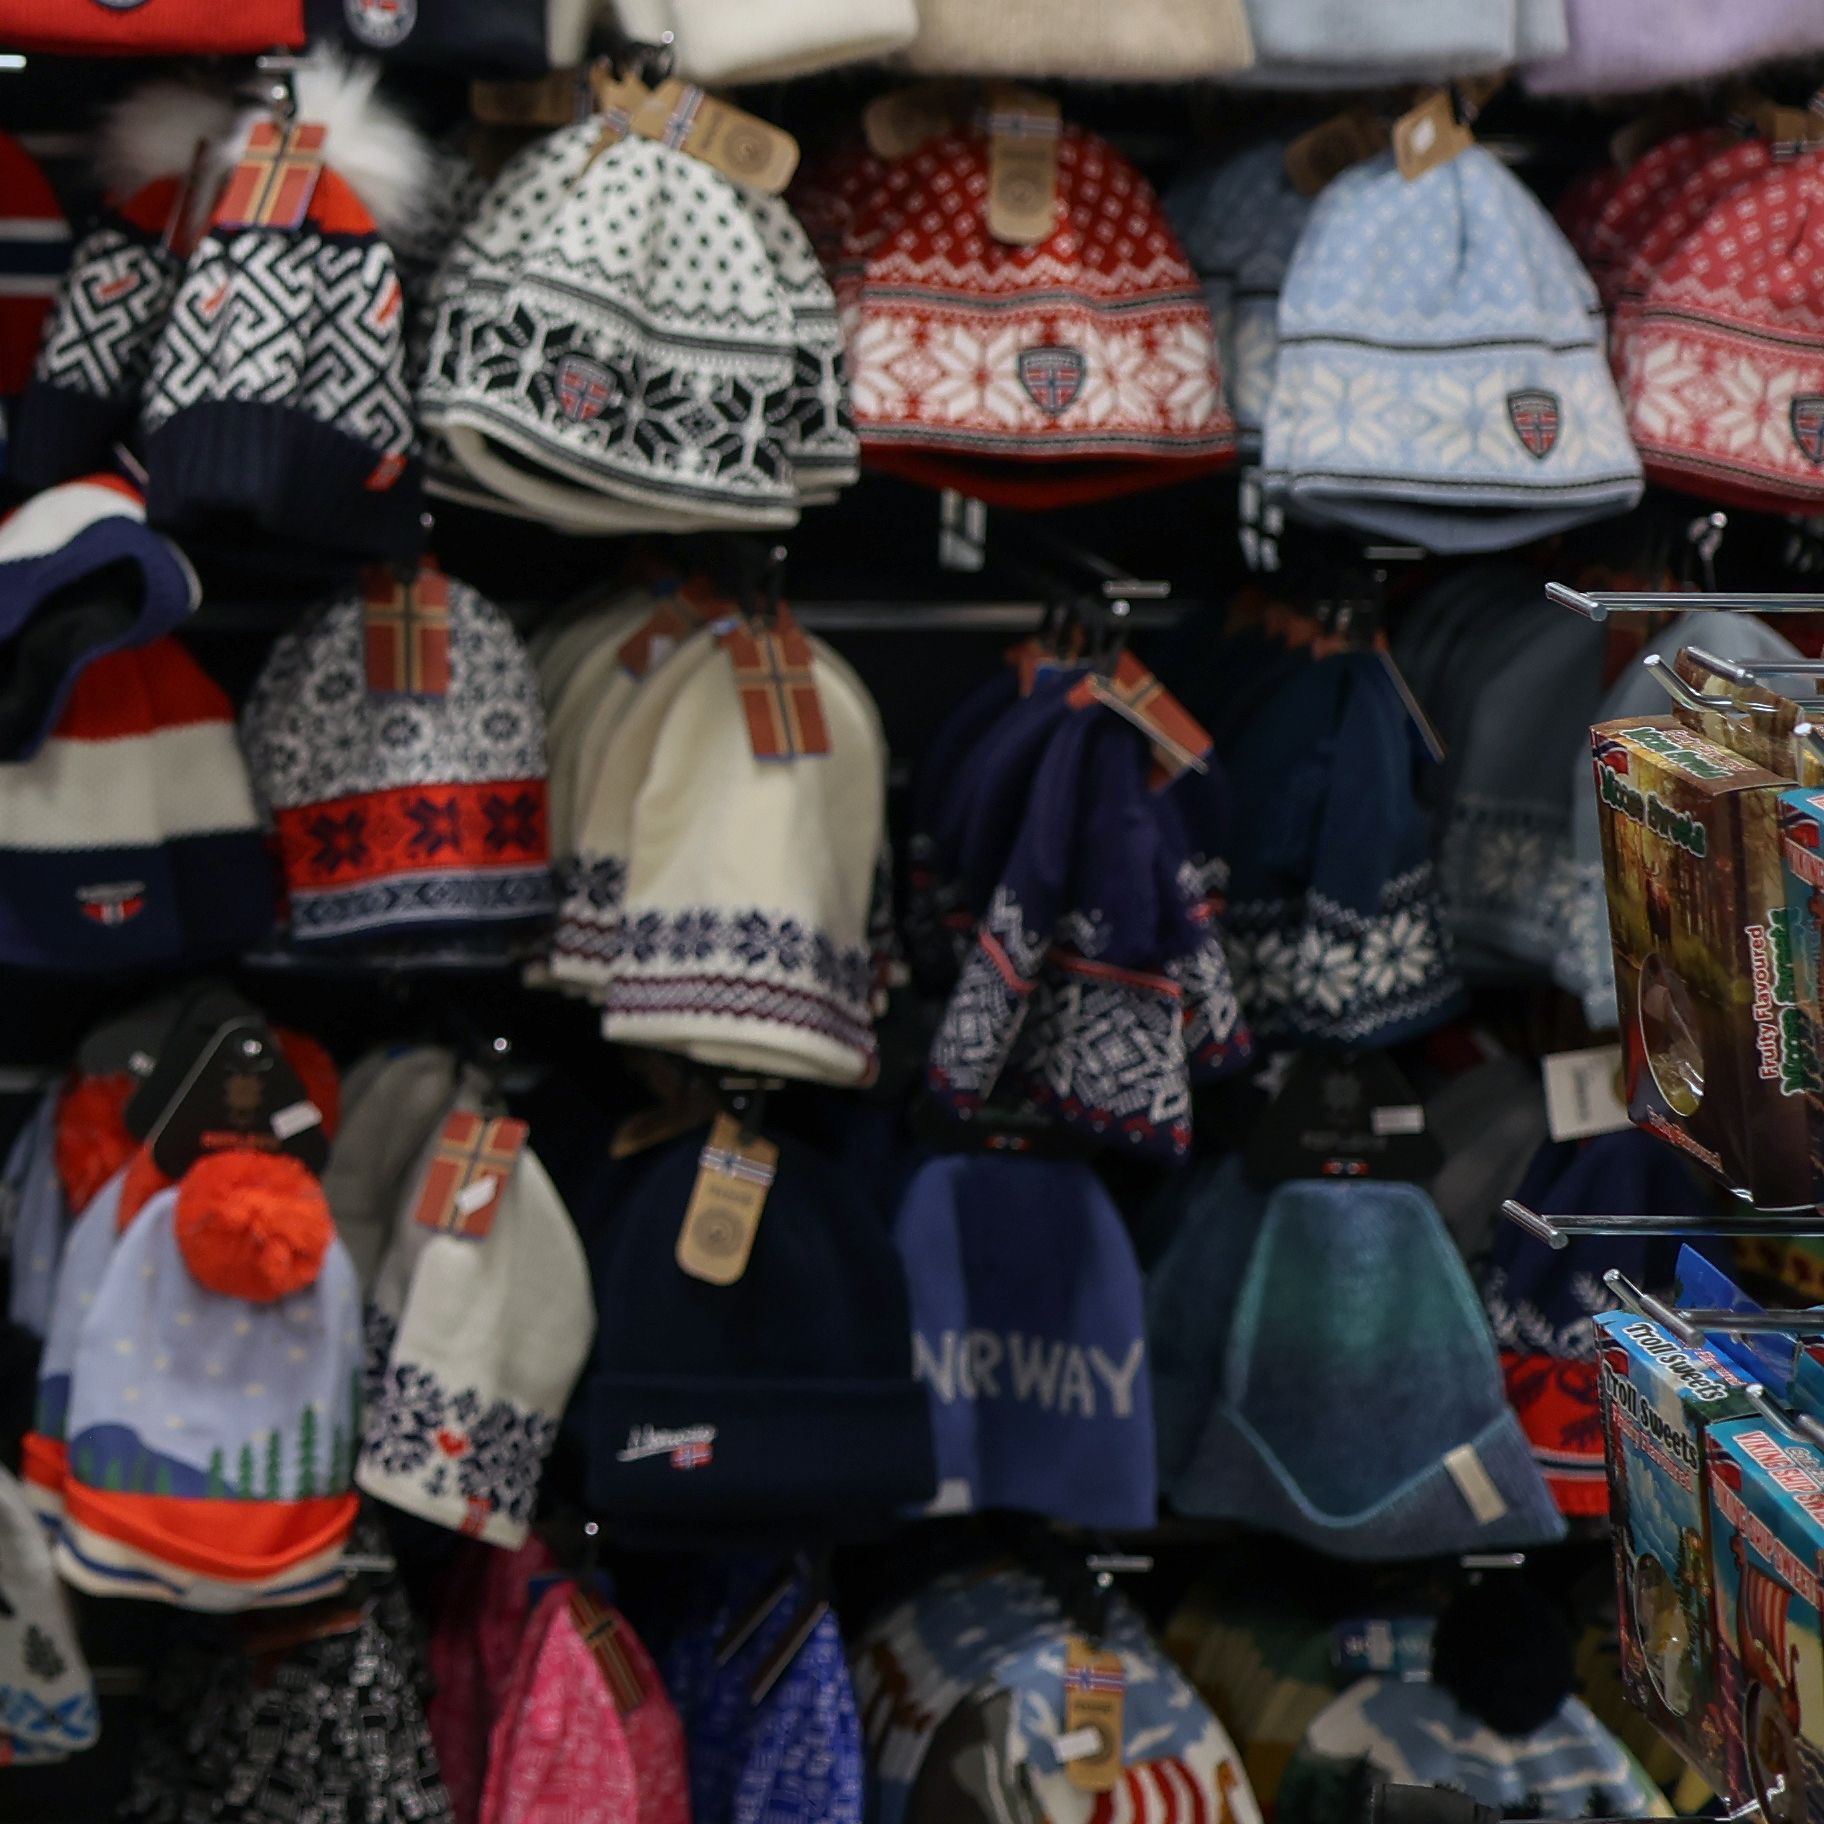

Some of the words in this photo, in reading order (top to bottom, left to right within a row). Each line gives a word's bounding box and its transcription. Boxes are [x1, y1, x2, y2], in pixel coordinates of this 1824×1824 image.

[1744, 925, 1773, 1021] Flavoured
[1758, 1023, 1780, 1079] Fruity
[911, 1328, 1145, 1420] NRWAY
[1623, 1322, 1681, 1357] Troll
[1656, 1350, 1729, 1401] Sweets
[1603, 1360, 1638, 1419] Troll
[1640, 1395, 1699, 1473] Sweets
[1733, 1431, 1793, 1470] VIKING
[1769, 1467, 1821, 1492] SHIP
